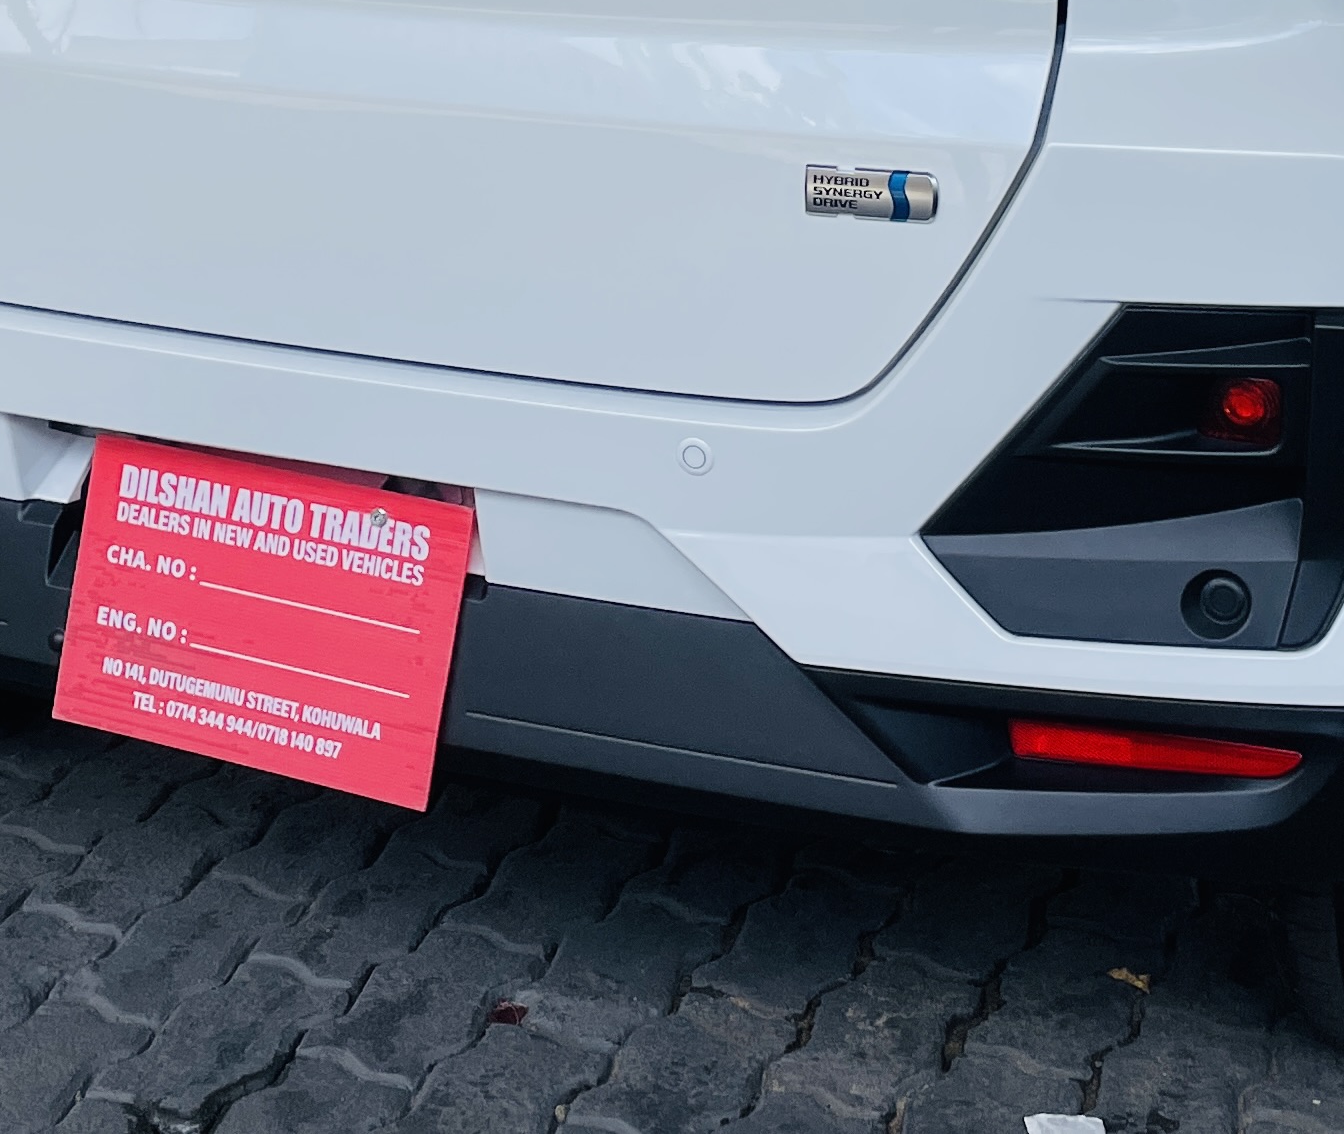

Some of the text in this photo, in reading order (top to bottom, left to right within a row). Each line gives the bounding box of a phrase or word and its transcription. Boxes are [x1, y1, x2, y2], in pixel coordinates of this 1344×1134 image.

[812, 174, 870, 188] HYBRID
[812, 186, 884, 200] SYNERGY
[812, 197, 858, 210] DRIVE
[119, 464, 430, 561] DILSHAN AUTO TRADERS
[117, 501, 424, 586] DEALERS IN NEW AND USED VEHICLES
[107, 545, 151, 571] CHA.
[97, 606, 142, 634] ENG.
[102, 657, 380, 740] NO 141, DUTUGEMUNU STREET, KOHUWALA
[166, 700, 197, 723] 0714
[197, 708, 225, 730] 344
[226, 715, 289, 746] 944/0718
[290, 731, 314, 752] 140
[315, 738, 342, 759] 897
